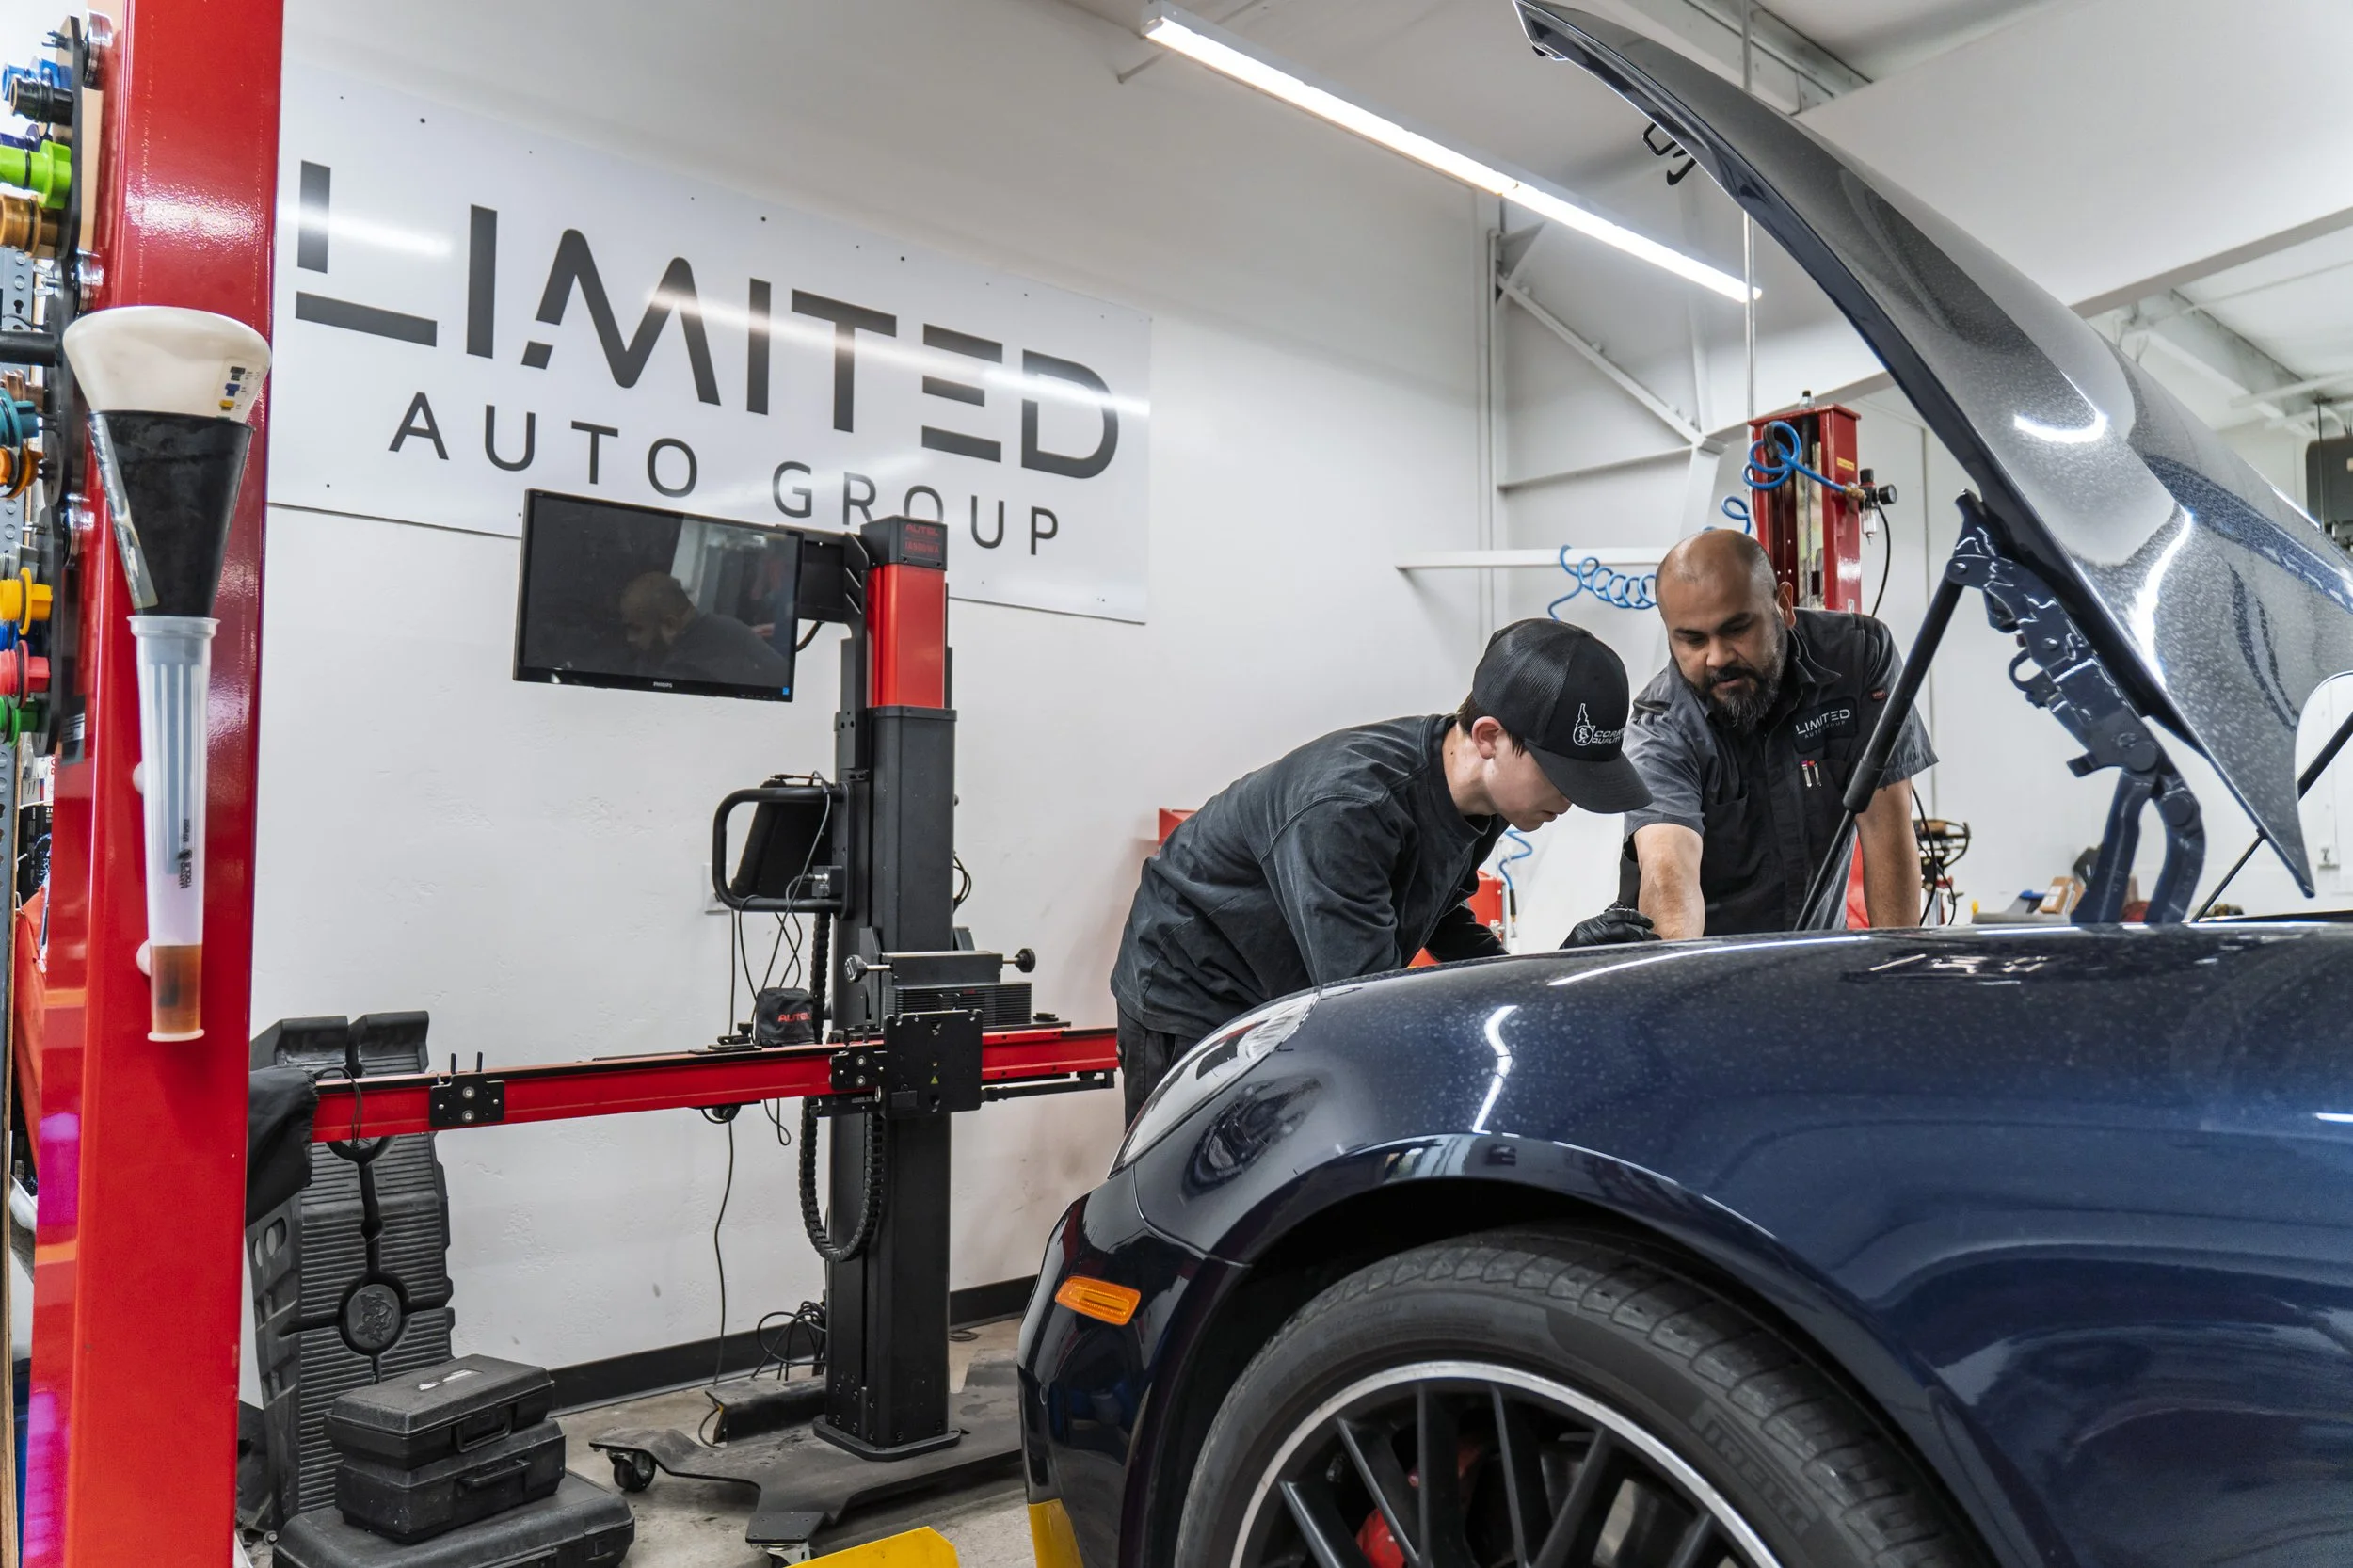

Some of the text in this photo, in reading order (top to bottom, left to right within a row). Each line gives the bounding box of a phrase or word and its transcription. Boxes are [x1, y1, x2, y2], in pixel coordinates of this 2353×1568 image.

[296, 160, 1118, 480] LIMITED
[389, 392, 1059, 556] AUTO GROUP
[1795, 709, 1851, 735] LIMITED
[1689, 1399, 1820, 1538] PIRELLI
